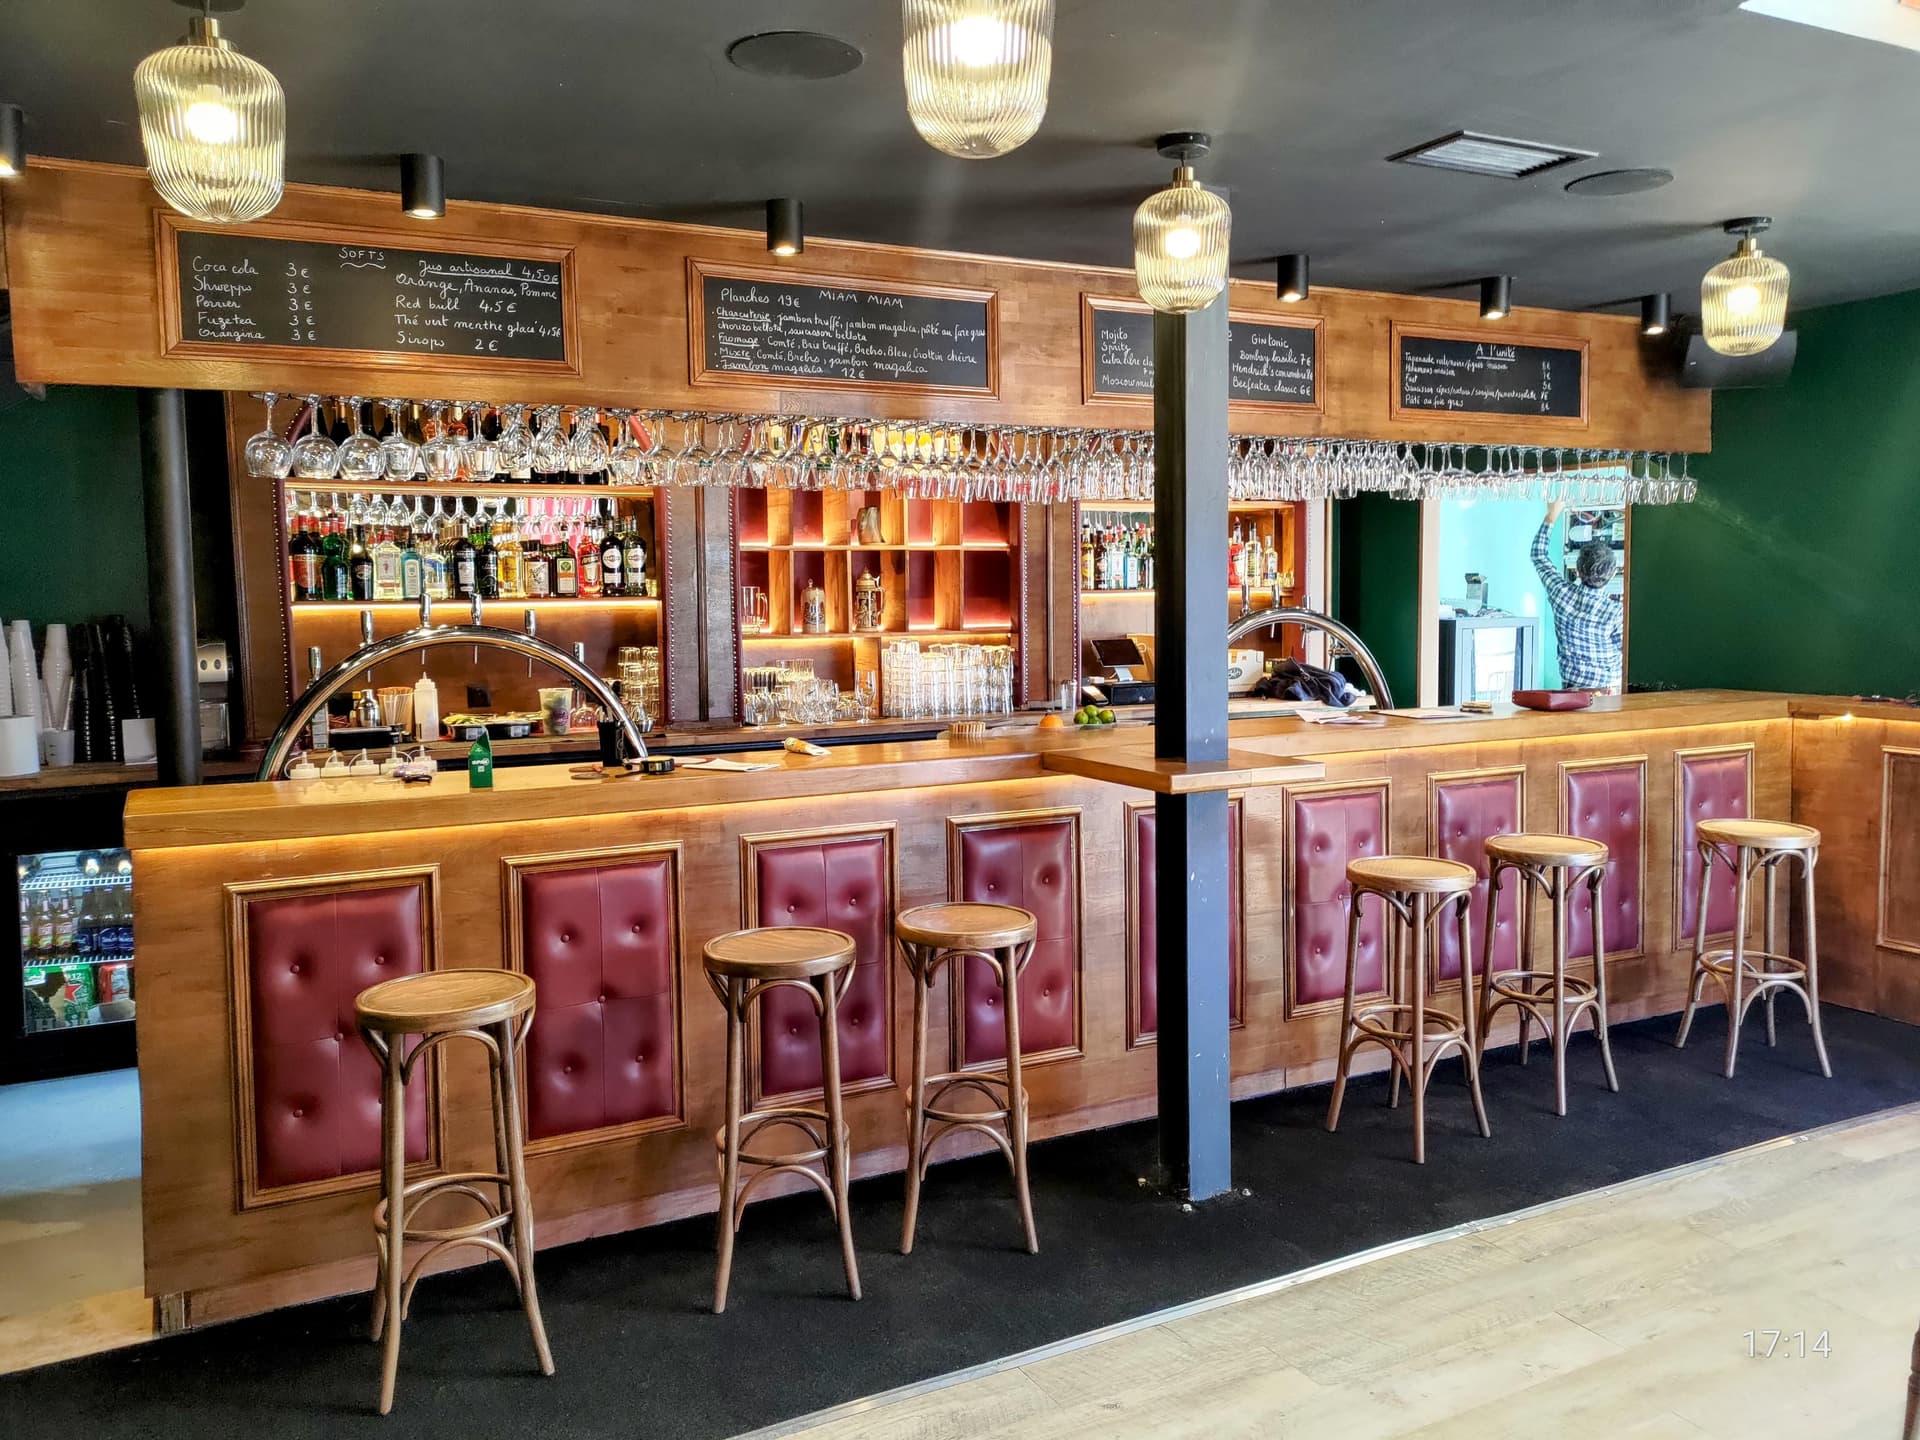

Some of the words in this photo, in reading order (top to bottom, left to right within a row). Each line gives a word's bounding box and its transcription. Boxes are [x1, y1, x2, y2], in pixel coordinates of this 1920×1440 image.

[339, 247, 384, 260] SOFTS
[192, 256, 227, 272] Coca
[232, 259, 258, 275] cola
[419, 260, 442, 278] Jus
[449, 261, 513, 276] artisanal
[522, 266, 559, 283] 4,50€
[192, 274, 252, 296] Shwepps
[396, 273, 462, 300] Orange,
[464, 278, 518, 297] Ananas,
[520, 282, 558, 300] Pomme
[196, 295, 240, 309] Perrier
[396, 294, 421, 310] Red
[429, 297, 461, 310] bull
[721, 286, 770, 304] Planches
[778, 294, 800, 308] 19€
[819, 290, 858, 303] MIAM
[867, 294, 904, 309] MIAM
[198, 312, 256, 330] Fuzetea
[394, 314, 418, 326] Thé
[425, 315, 449, 327] vert
[454, 320, 503, 332] menthe
[777, 312, 812, 326] jambon
[198, 328, 265, 342] Orangina
[396, 331, 446, 350] Sirops
[1102, 327, 1128, 344] Mojito
[1268, 332, 1289, 348] tonic
[1102, 352, 1122, 365] Cuba
[1240, 348, 1270, 368] Bombay
[1102, 374, 1135, 386] Moscow
